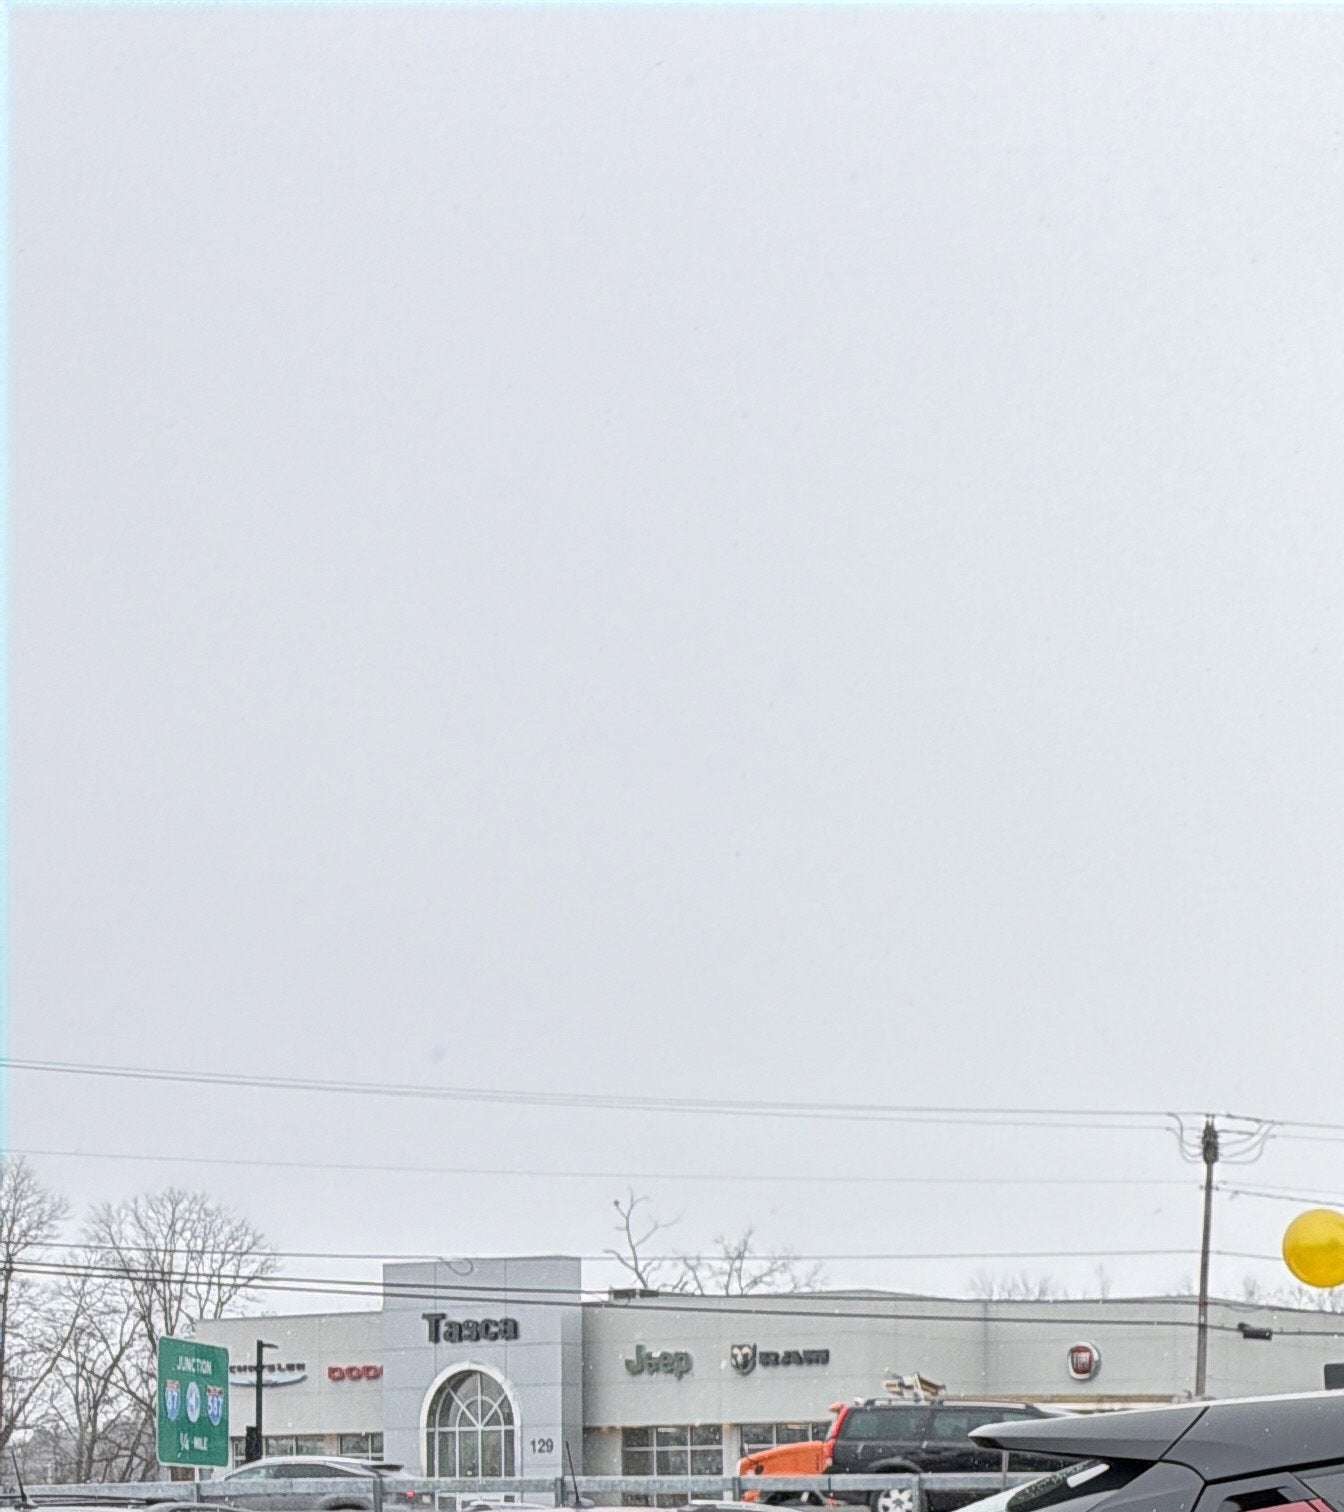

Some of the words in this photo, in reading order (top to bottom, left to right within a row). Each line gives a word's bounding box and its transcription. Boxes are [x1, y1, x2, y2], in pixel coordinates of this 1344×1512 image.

[422, 1312, 520, 1344] Tasca
[176, 1355, 213, 1375] JUNCTION
[625, 1344, 694, 1381] Jeep
[758, 1348, 830, 1367] RAM
[327, 1365, 384, 1381] DOD
[530, 1437, 554, 1455] 129
